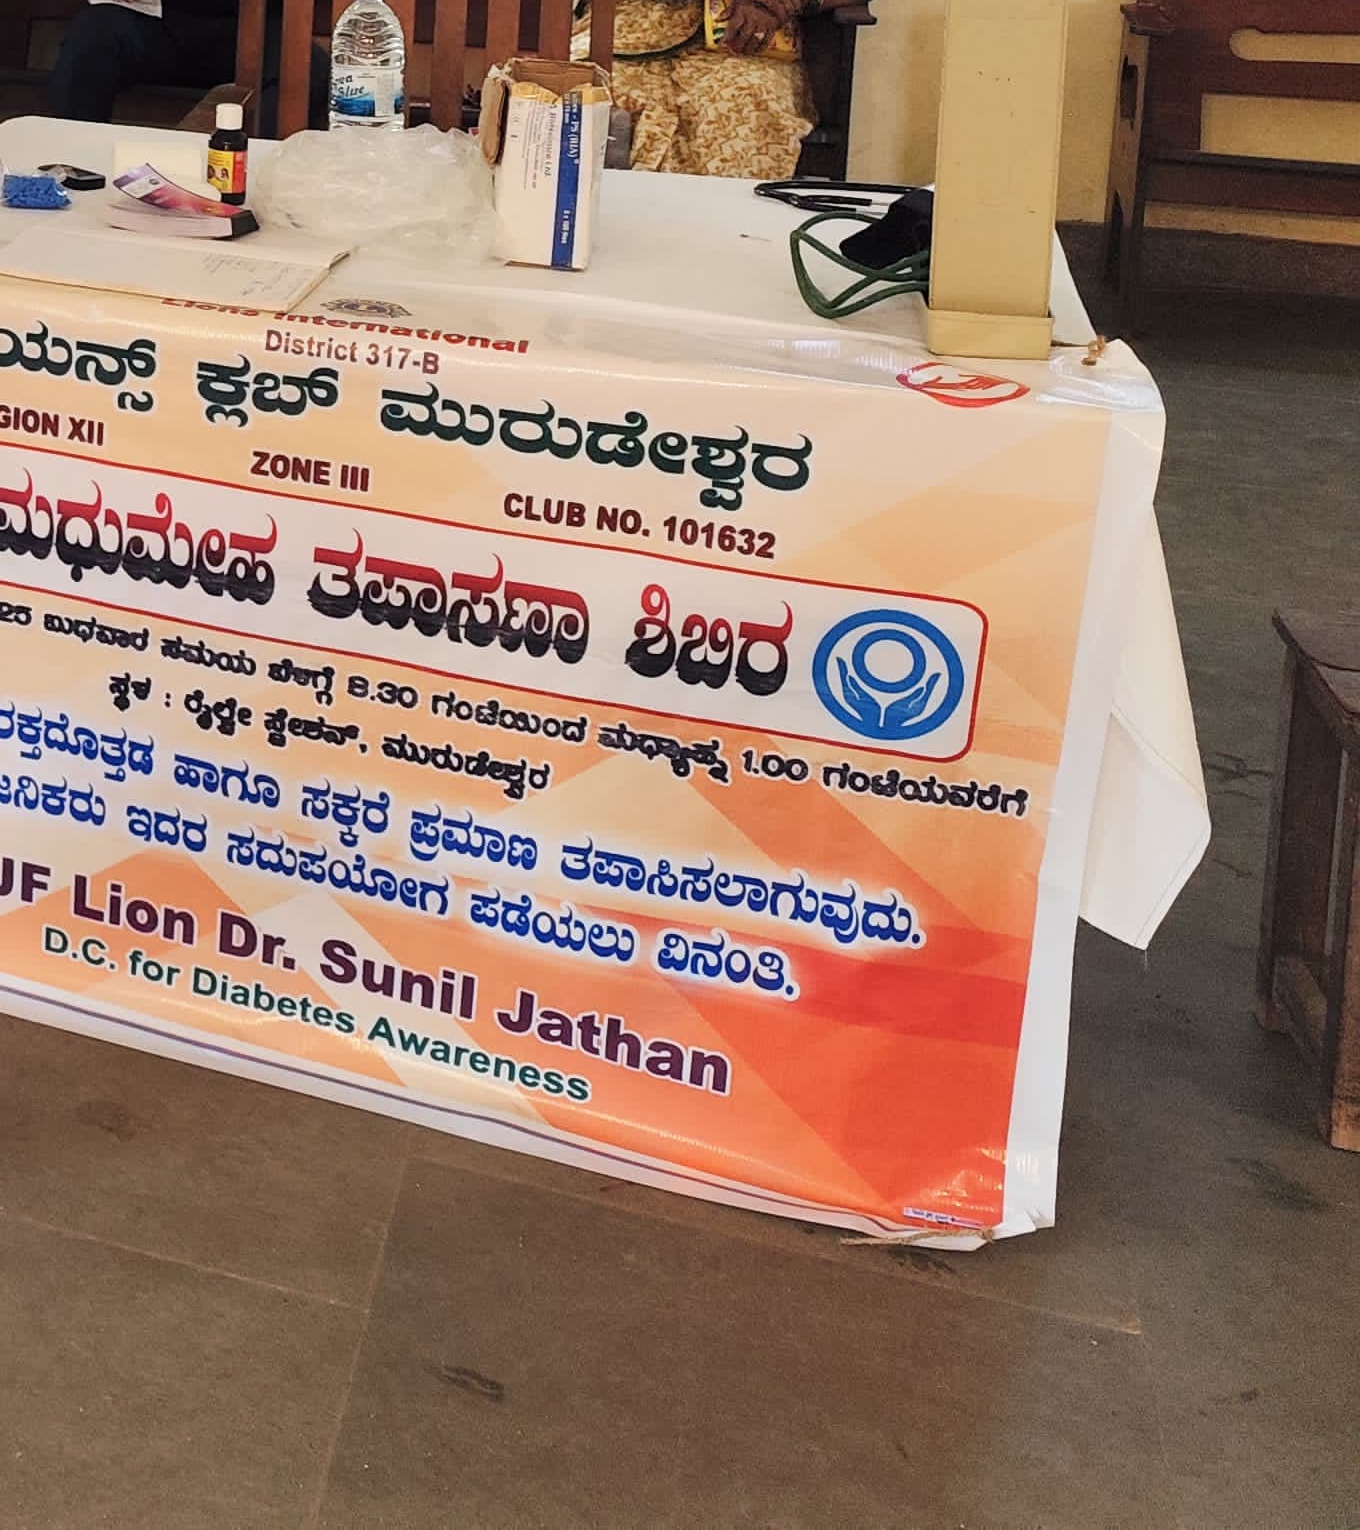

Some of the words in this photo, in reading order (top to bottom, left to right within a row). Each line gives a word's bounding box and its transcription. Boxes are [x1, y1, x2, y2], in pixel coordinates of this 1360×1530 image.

[265, 330, 357, 362] District
[366, 343, 440, 375] 317-B
[275, 312, 529, 354] International
[68, 417, 105, 447] XII
[197, 355, 338, 428] ಕ್ಲಬ್
[380, 382, 813, 511] ಮುರುಡೇಶ್ವರ
[250, 450, 332, 487] ZONE
[340, 466, 370, 493] III
[504, 492, 586, 528] CLUB
[597, 506, 651, 538] NO.
[663, 515, 776, 559] 101632
[625, 583, 794, 698] ಶಿಬಿರ
[174, 752, 281, 807] ಹಾಗೂ
[301, 779, 390, 847] ಸಕ್ಕರೆ
[409, 803, 538, 872] ಪ್ರಮಾಣ
[127, 805, 208, 853] ಇದರ
[471, 888, 636, 964] ಪಡೆಯಲು
[44, 927, 116, 971] D.C.
[128, 949, 179, 989] for
[191, 967, 355, 1034] Diabetes
[368, 1017, 590, 1102] Awareness
[72, 873, 196, 946] Lion
[217, 911, 296, 970] Dr.
[320, 937, 476, 1020] Sunil
[497, 990, 730, 1094] Jathan
